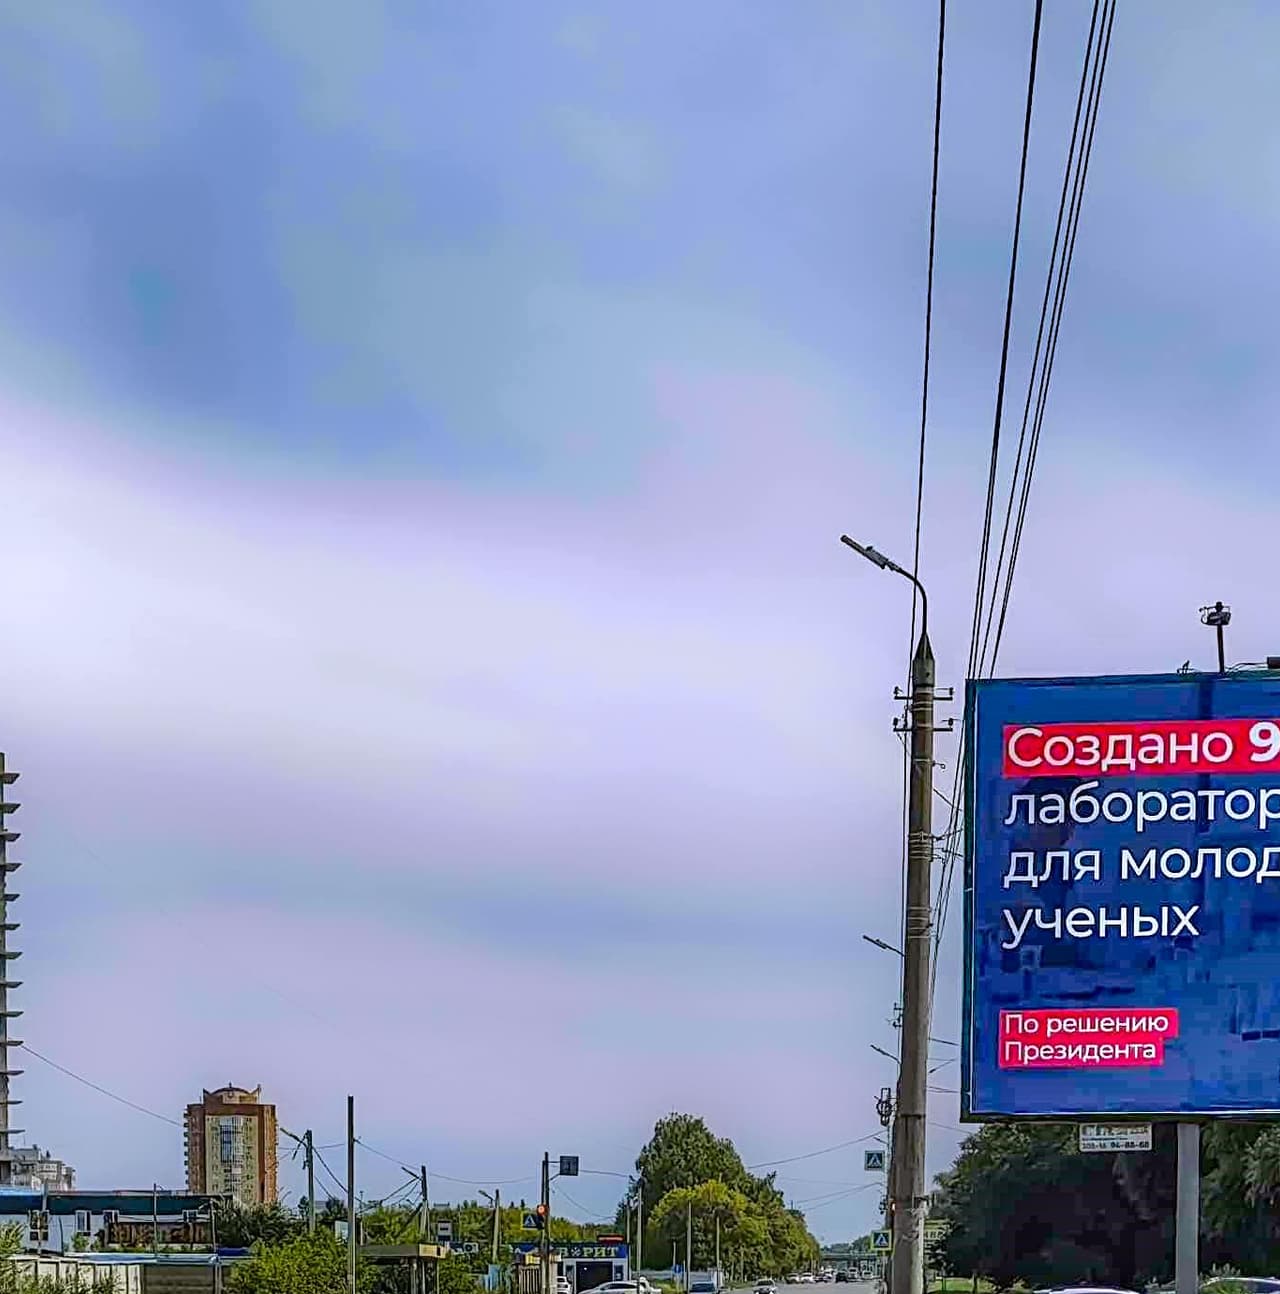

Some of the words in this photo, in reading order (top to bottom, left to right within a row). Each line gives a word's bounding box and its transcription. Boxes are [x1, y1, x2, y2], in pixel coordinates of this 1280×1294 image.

[1007, 727, 1234, 772] Создано
[1004, 849, 1101, 888] для
[1002, 904, 1200, 950] ученых
[1005, 1013, 1040, 1034] По
[1046, 1015, 1169, 1038] решению
[1005, 1041, 1156, 1065] Президента
